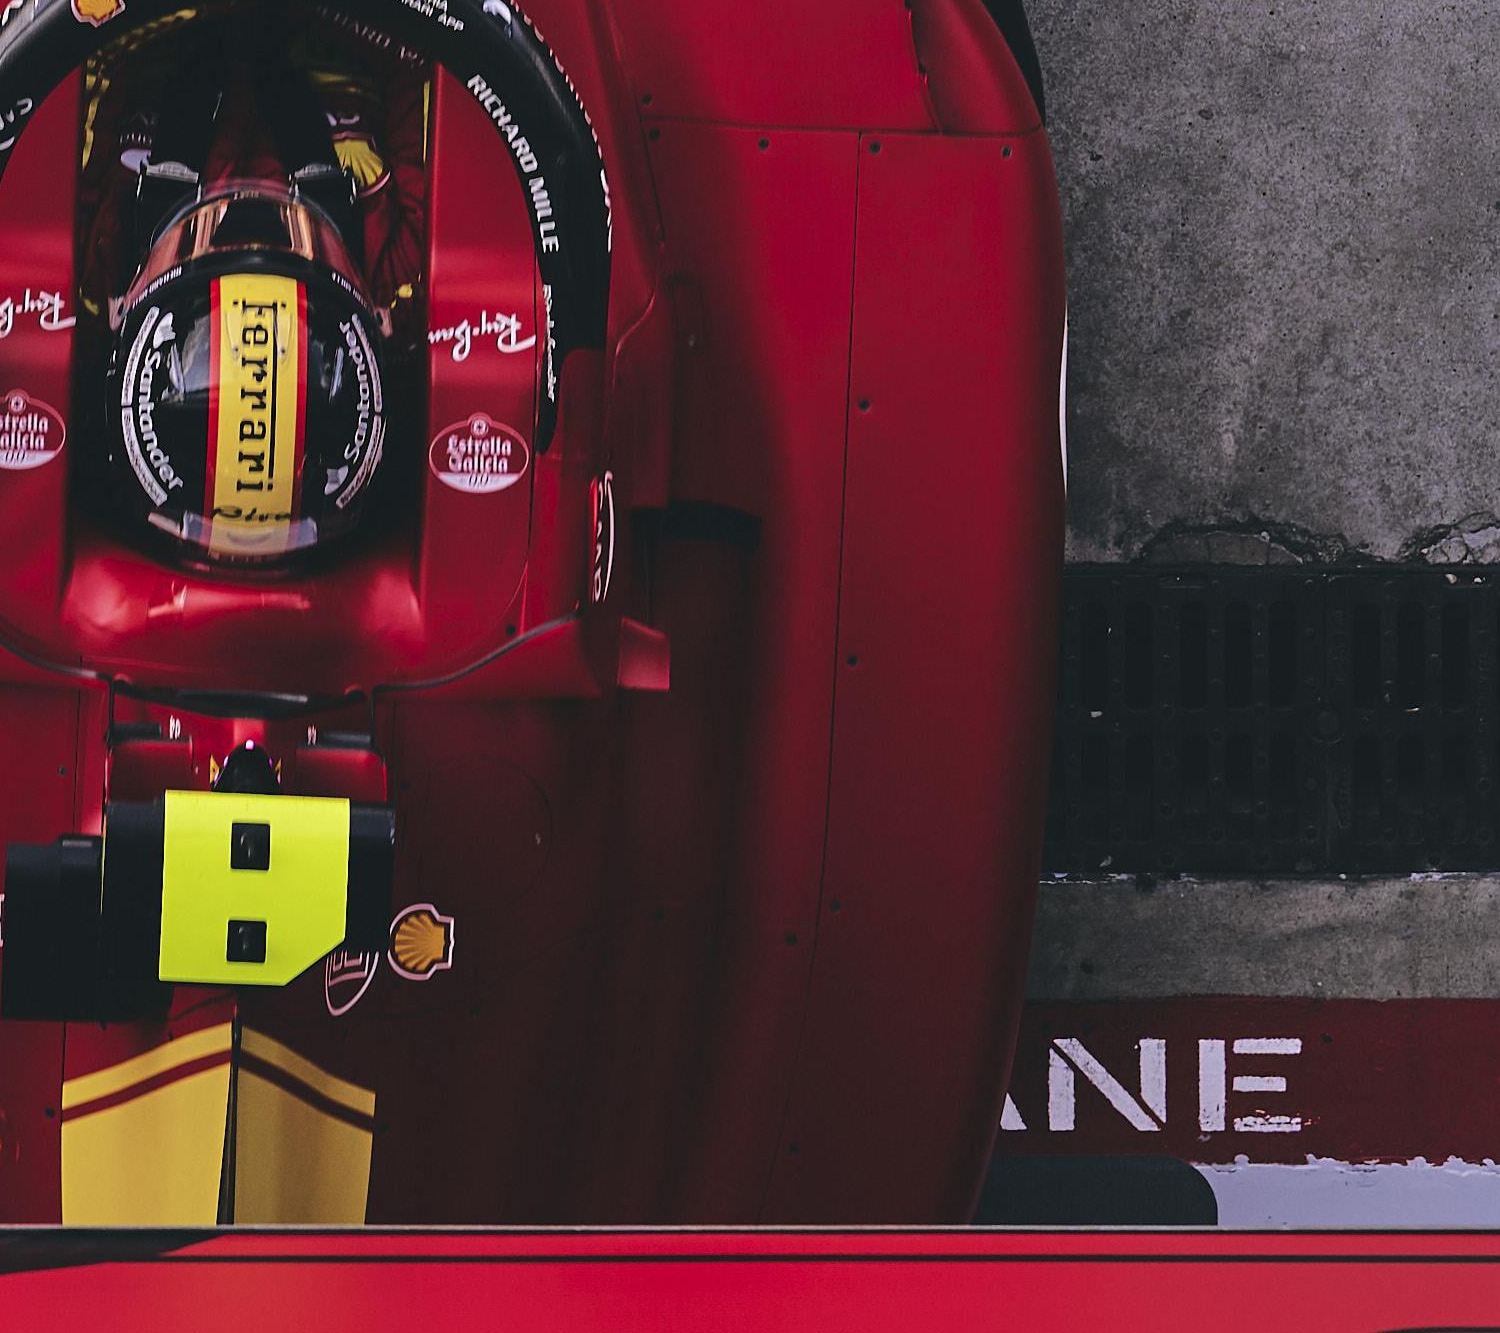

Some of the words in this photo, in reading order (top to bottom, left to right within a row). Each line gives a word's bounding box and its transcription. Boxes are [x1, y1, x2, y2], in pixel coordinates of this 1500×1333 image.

[437, 13, 465, 31] APP
[466, 73, 539, 174] RICHARD
[528, 176, 560, 254] MILLE
[138, 348, 184, 491] Santander
[236, 298, 280, 494] Ferrari
[339, 320, 371, 466] Santander
[446, 433, 512, 457] Estrella
[448, 452, 509, 474] Galicia
